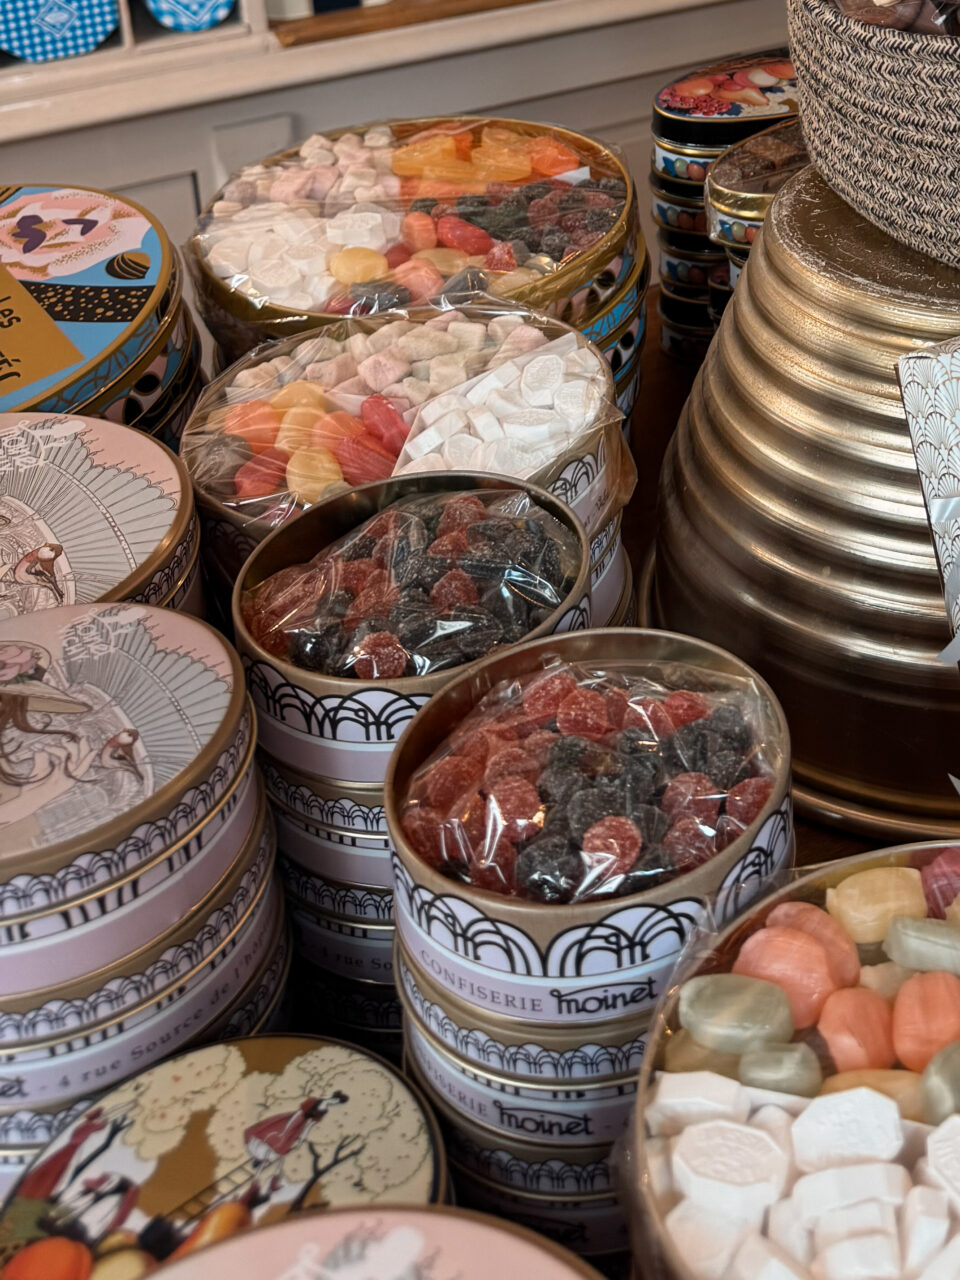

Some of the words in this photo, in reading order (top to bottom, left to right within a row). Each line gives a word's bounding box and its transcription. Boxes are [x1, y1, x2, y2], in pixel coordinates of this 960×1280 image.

[419, 949, 544, 1013] CONFISERIE
[550, 977, 658, 1015] moinet
[82, 1058, 121, 1082] rue
[131, 1007, 202, 1060] Source
[211, 981, 230, 1005] de
[493, 1100, 593, 1136] moinet
